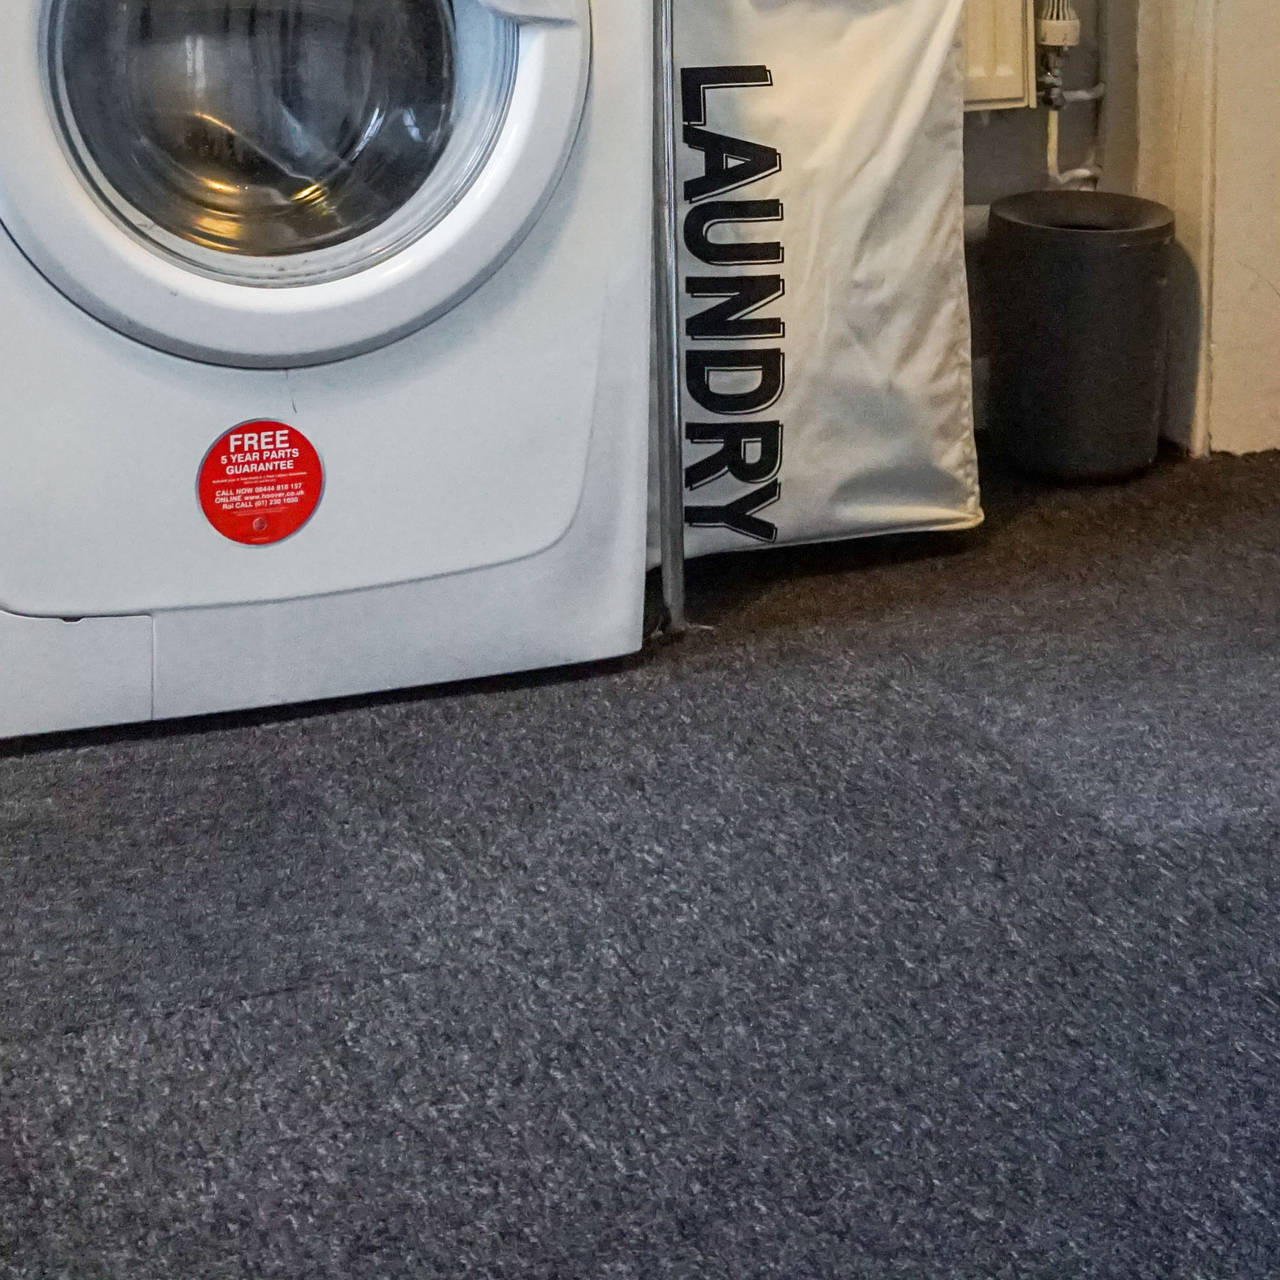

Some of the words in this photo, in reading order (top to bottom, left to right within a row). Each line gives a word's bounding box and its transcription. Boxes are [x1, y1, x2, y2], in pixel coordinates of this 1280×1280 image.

[680, 65, 785, 543] LAUNDRY
[229, 430, 290, 452] FREE
[221, 455, 228, 464] 5
[230, 452, 260, 463] YEAR
[263, 448, 299, 460] PARTS
[225, 460, 294, 475] GUARANTEE
[216, 488, 234, 497] CALL
[236, 487, 253, 495] NOW
